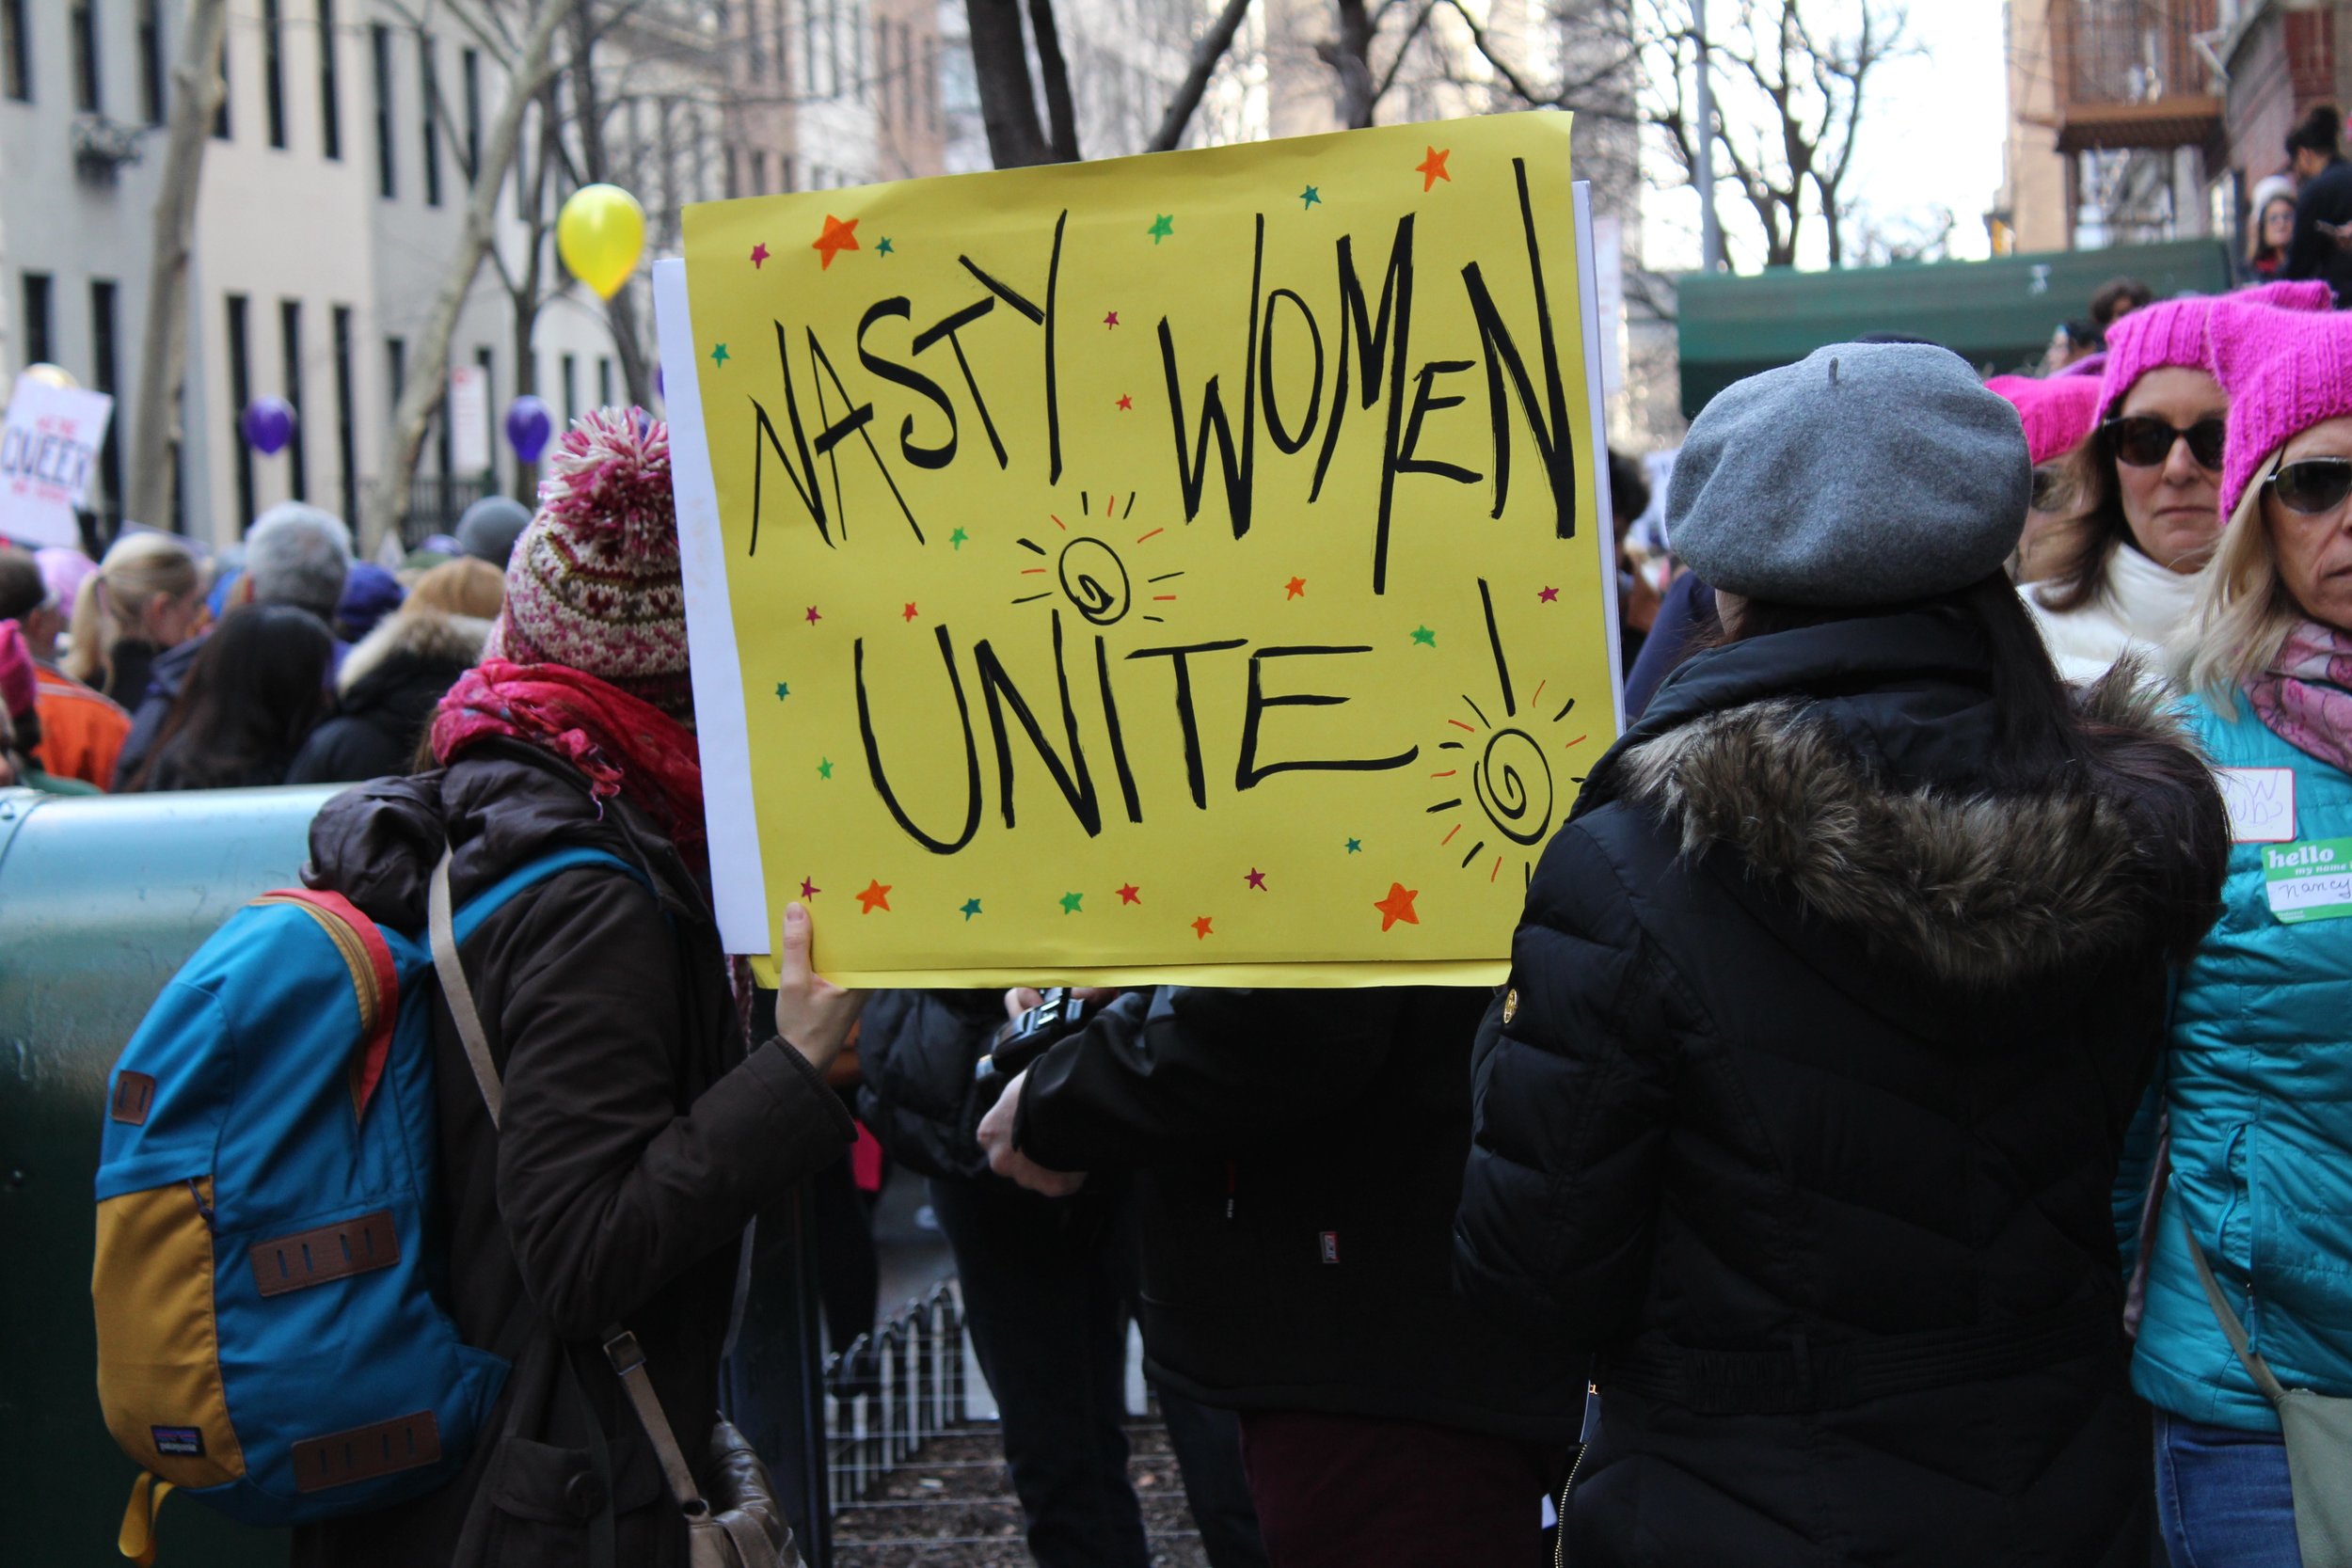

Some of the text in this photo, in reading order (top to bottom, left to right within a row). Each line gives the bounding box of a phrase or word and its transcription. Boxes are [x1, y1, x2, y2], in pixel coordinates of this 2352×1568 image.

[748, 157, 1577, 596] NASTY WOMEN
[2267, 845, 2334, 869] hello
[2295, 866, 2313, 877] my
[2316, 863, 2347, 873] name
